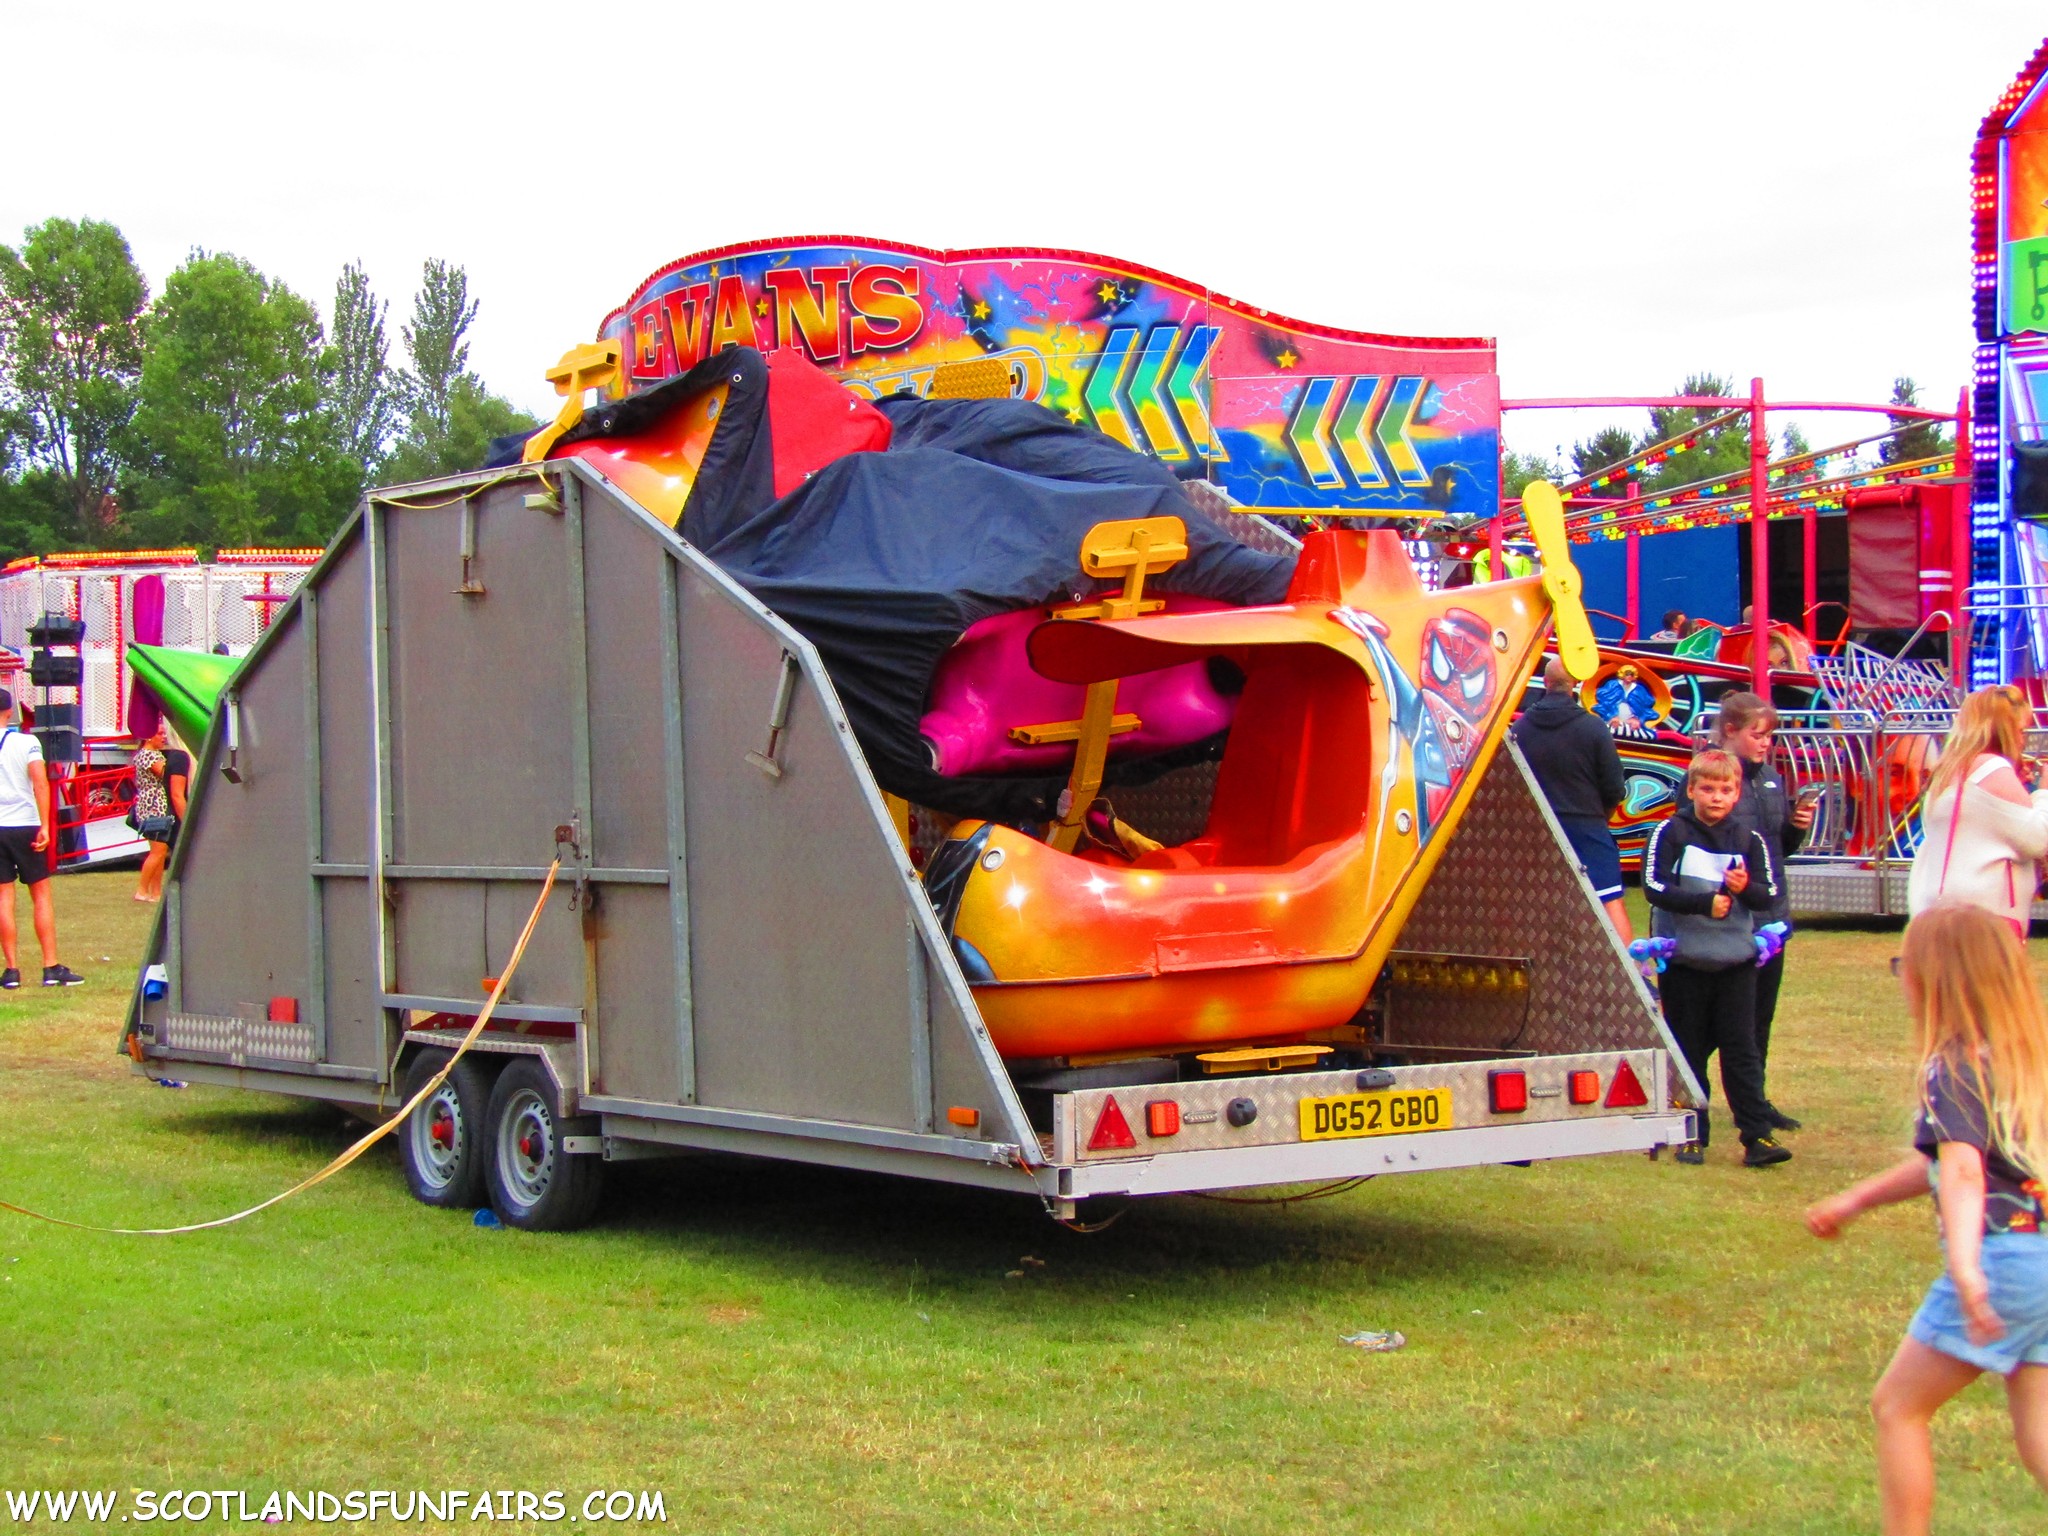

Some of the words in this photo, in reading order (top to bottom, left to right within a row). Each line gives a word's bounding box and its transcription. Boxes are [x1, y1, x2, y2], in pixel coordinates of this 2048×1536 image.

[631, 264, 924, 380] EVANS
[1314, 1099, 1382, 1134] DG52
[1390, 1094, 1439, 1127] GBO
